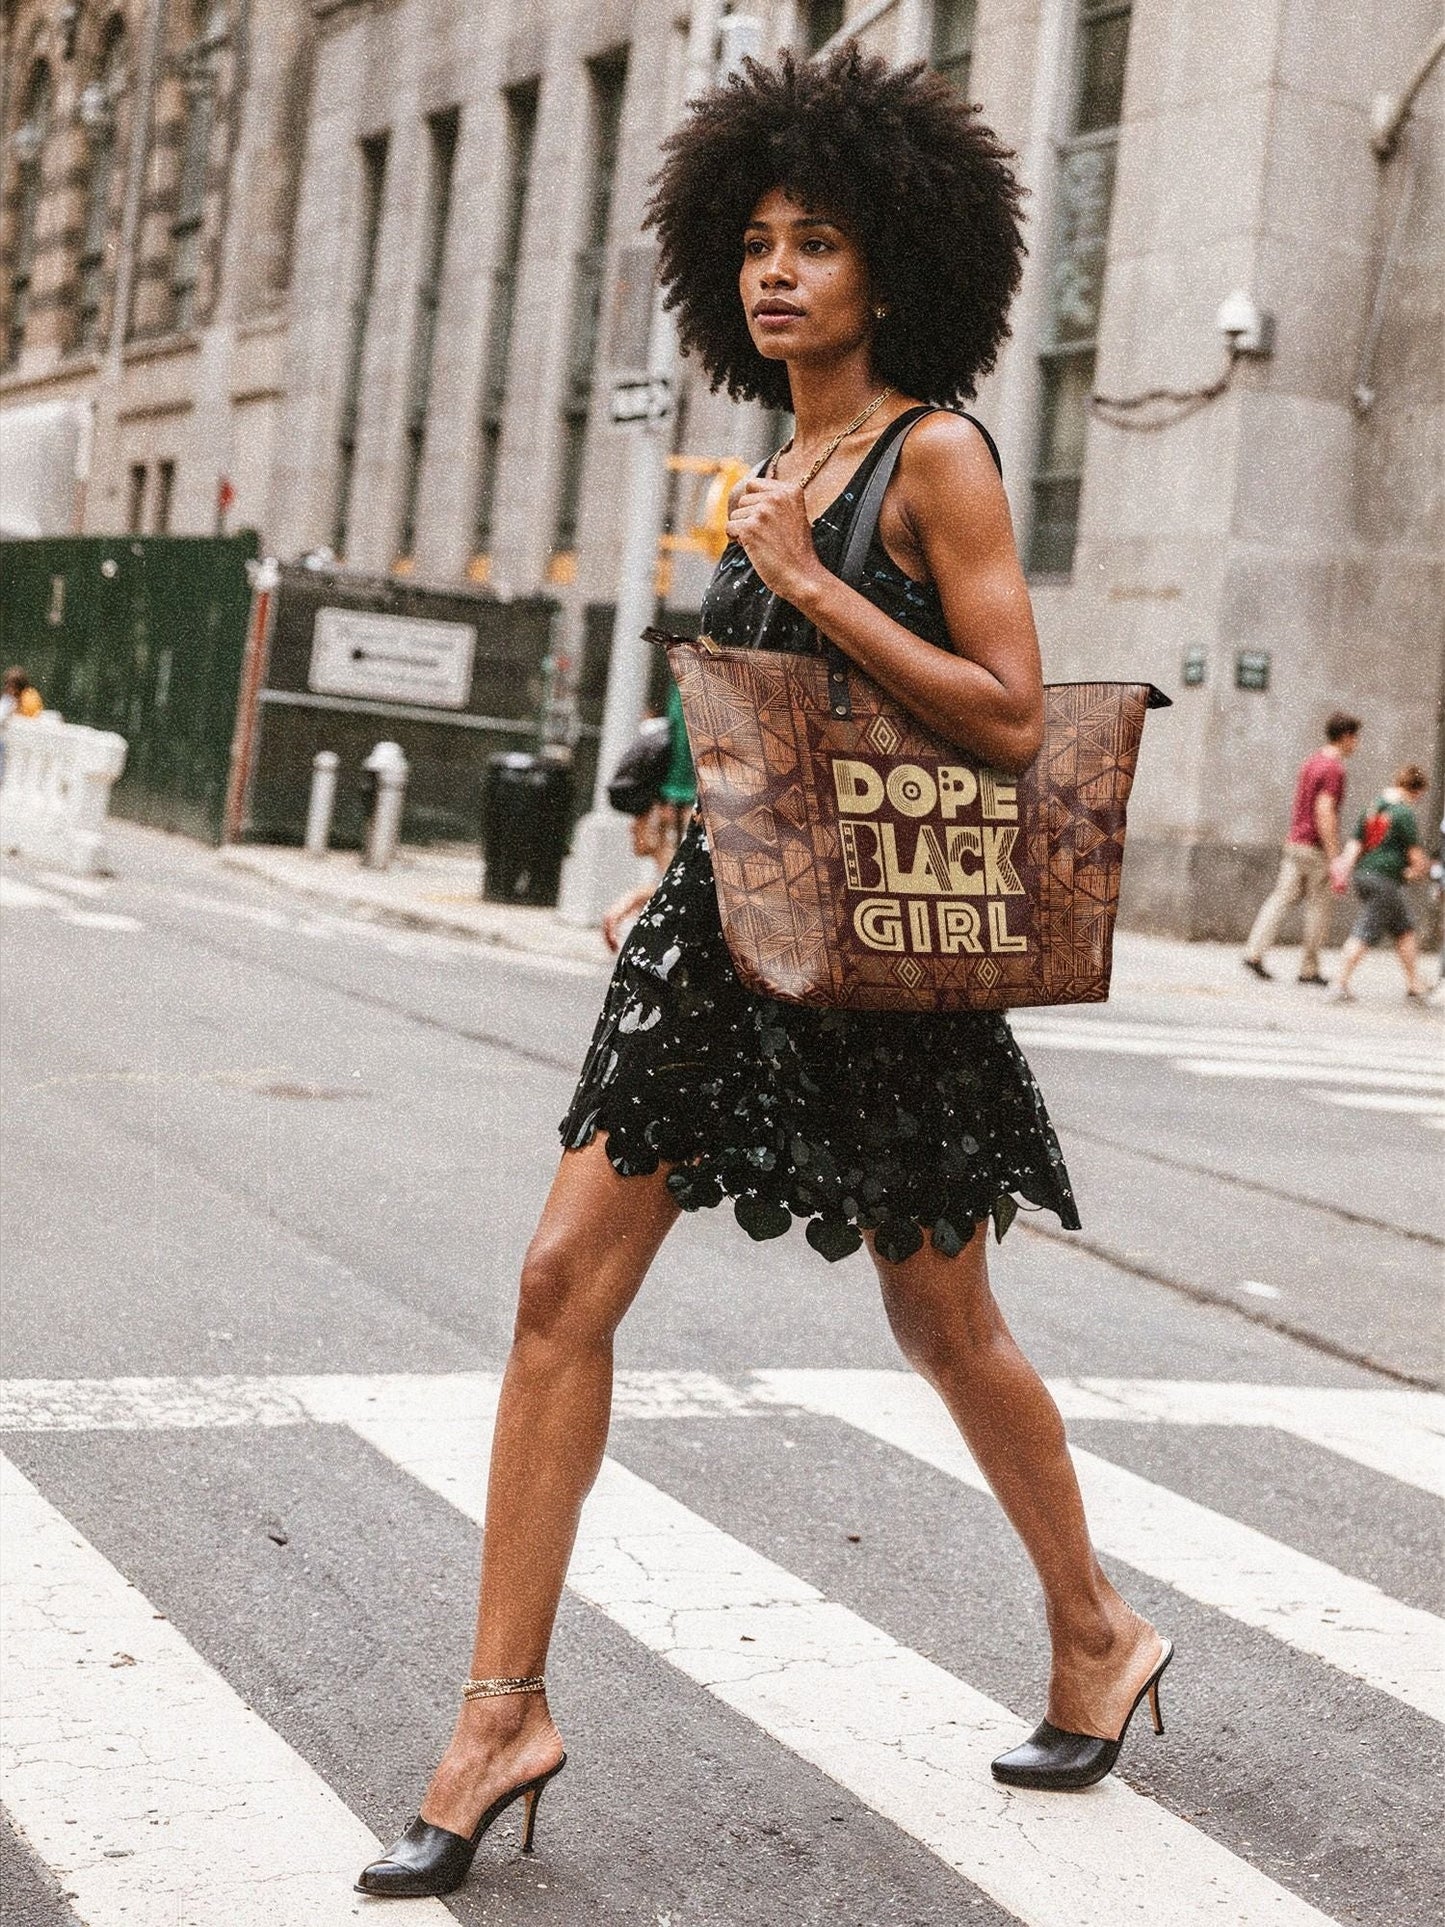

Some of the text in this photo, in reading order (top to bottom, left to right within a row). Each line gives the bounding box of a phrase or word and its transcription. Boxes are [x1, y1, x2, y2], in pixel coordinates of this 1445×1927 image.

[832, 759, 1018, 820] DOPE
[839, 820, 1026, 895] BLACK
[853, 898, 1028, 953] GIRL
